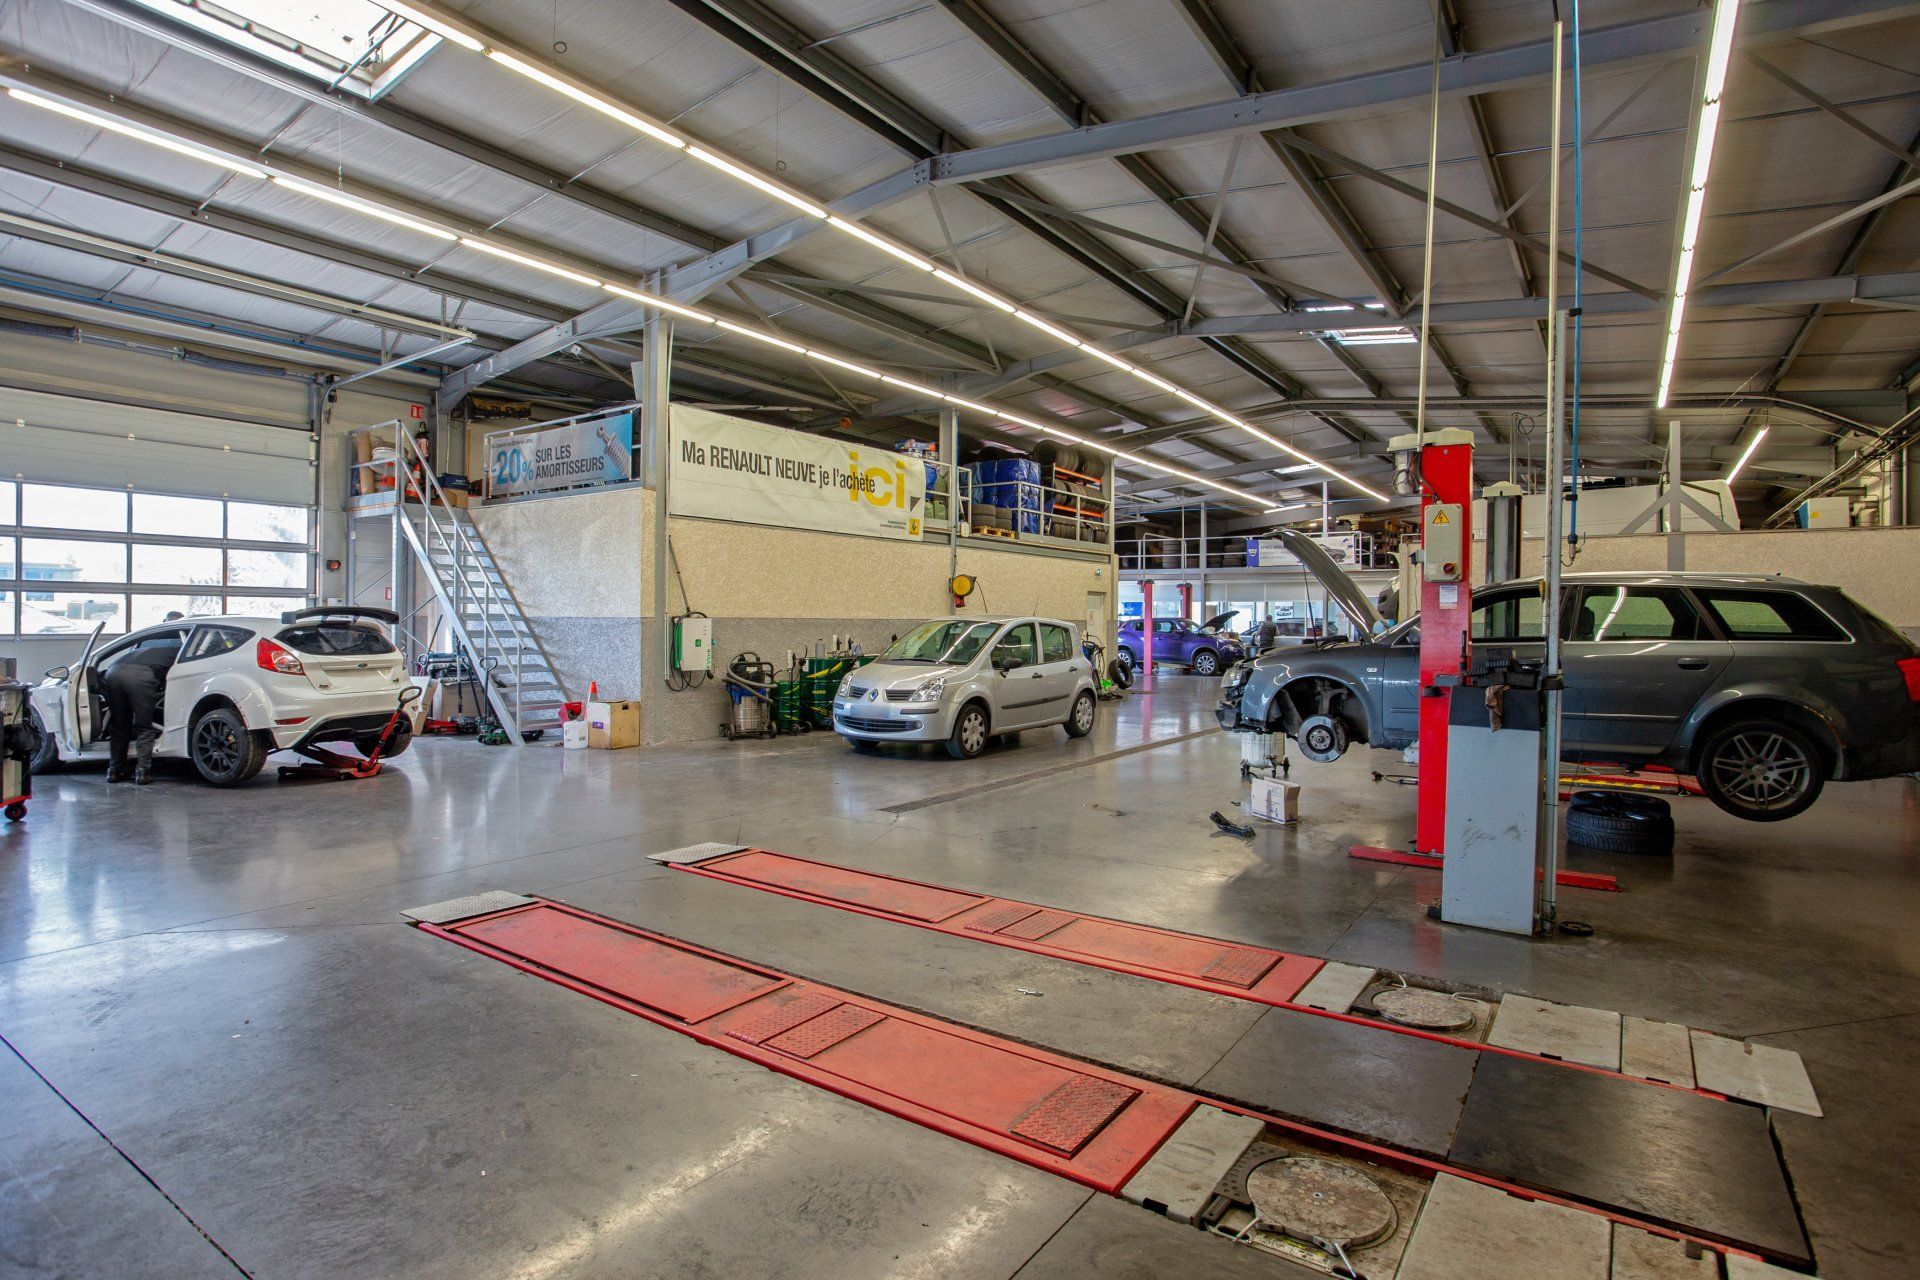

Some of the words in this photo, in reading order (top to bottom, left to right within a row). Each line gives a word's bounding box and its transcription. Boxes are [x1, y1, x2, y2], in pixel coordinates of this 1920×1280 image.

[490, 448, 534, 484] -20%
[535, 446, 553, 463] SUR
[555, 444, 571, 460] LES
[535, 456, 604, 480] AMORTISSEURS
[682, 440, 705, 465] Ma
[710, 445, 772, 476] RENAULT
[775, 457, 816, 484] NEUVE
[819, 465, 830, 489] je
[833, 468, 876, 493] l'achète
[849, 450, 905, 509] ici
